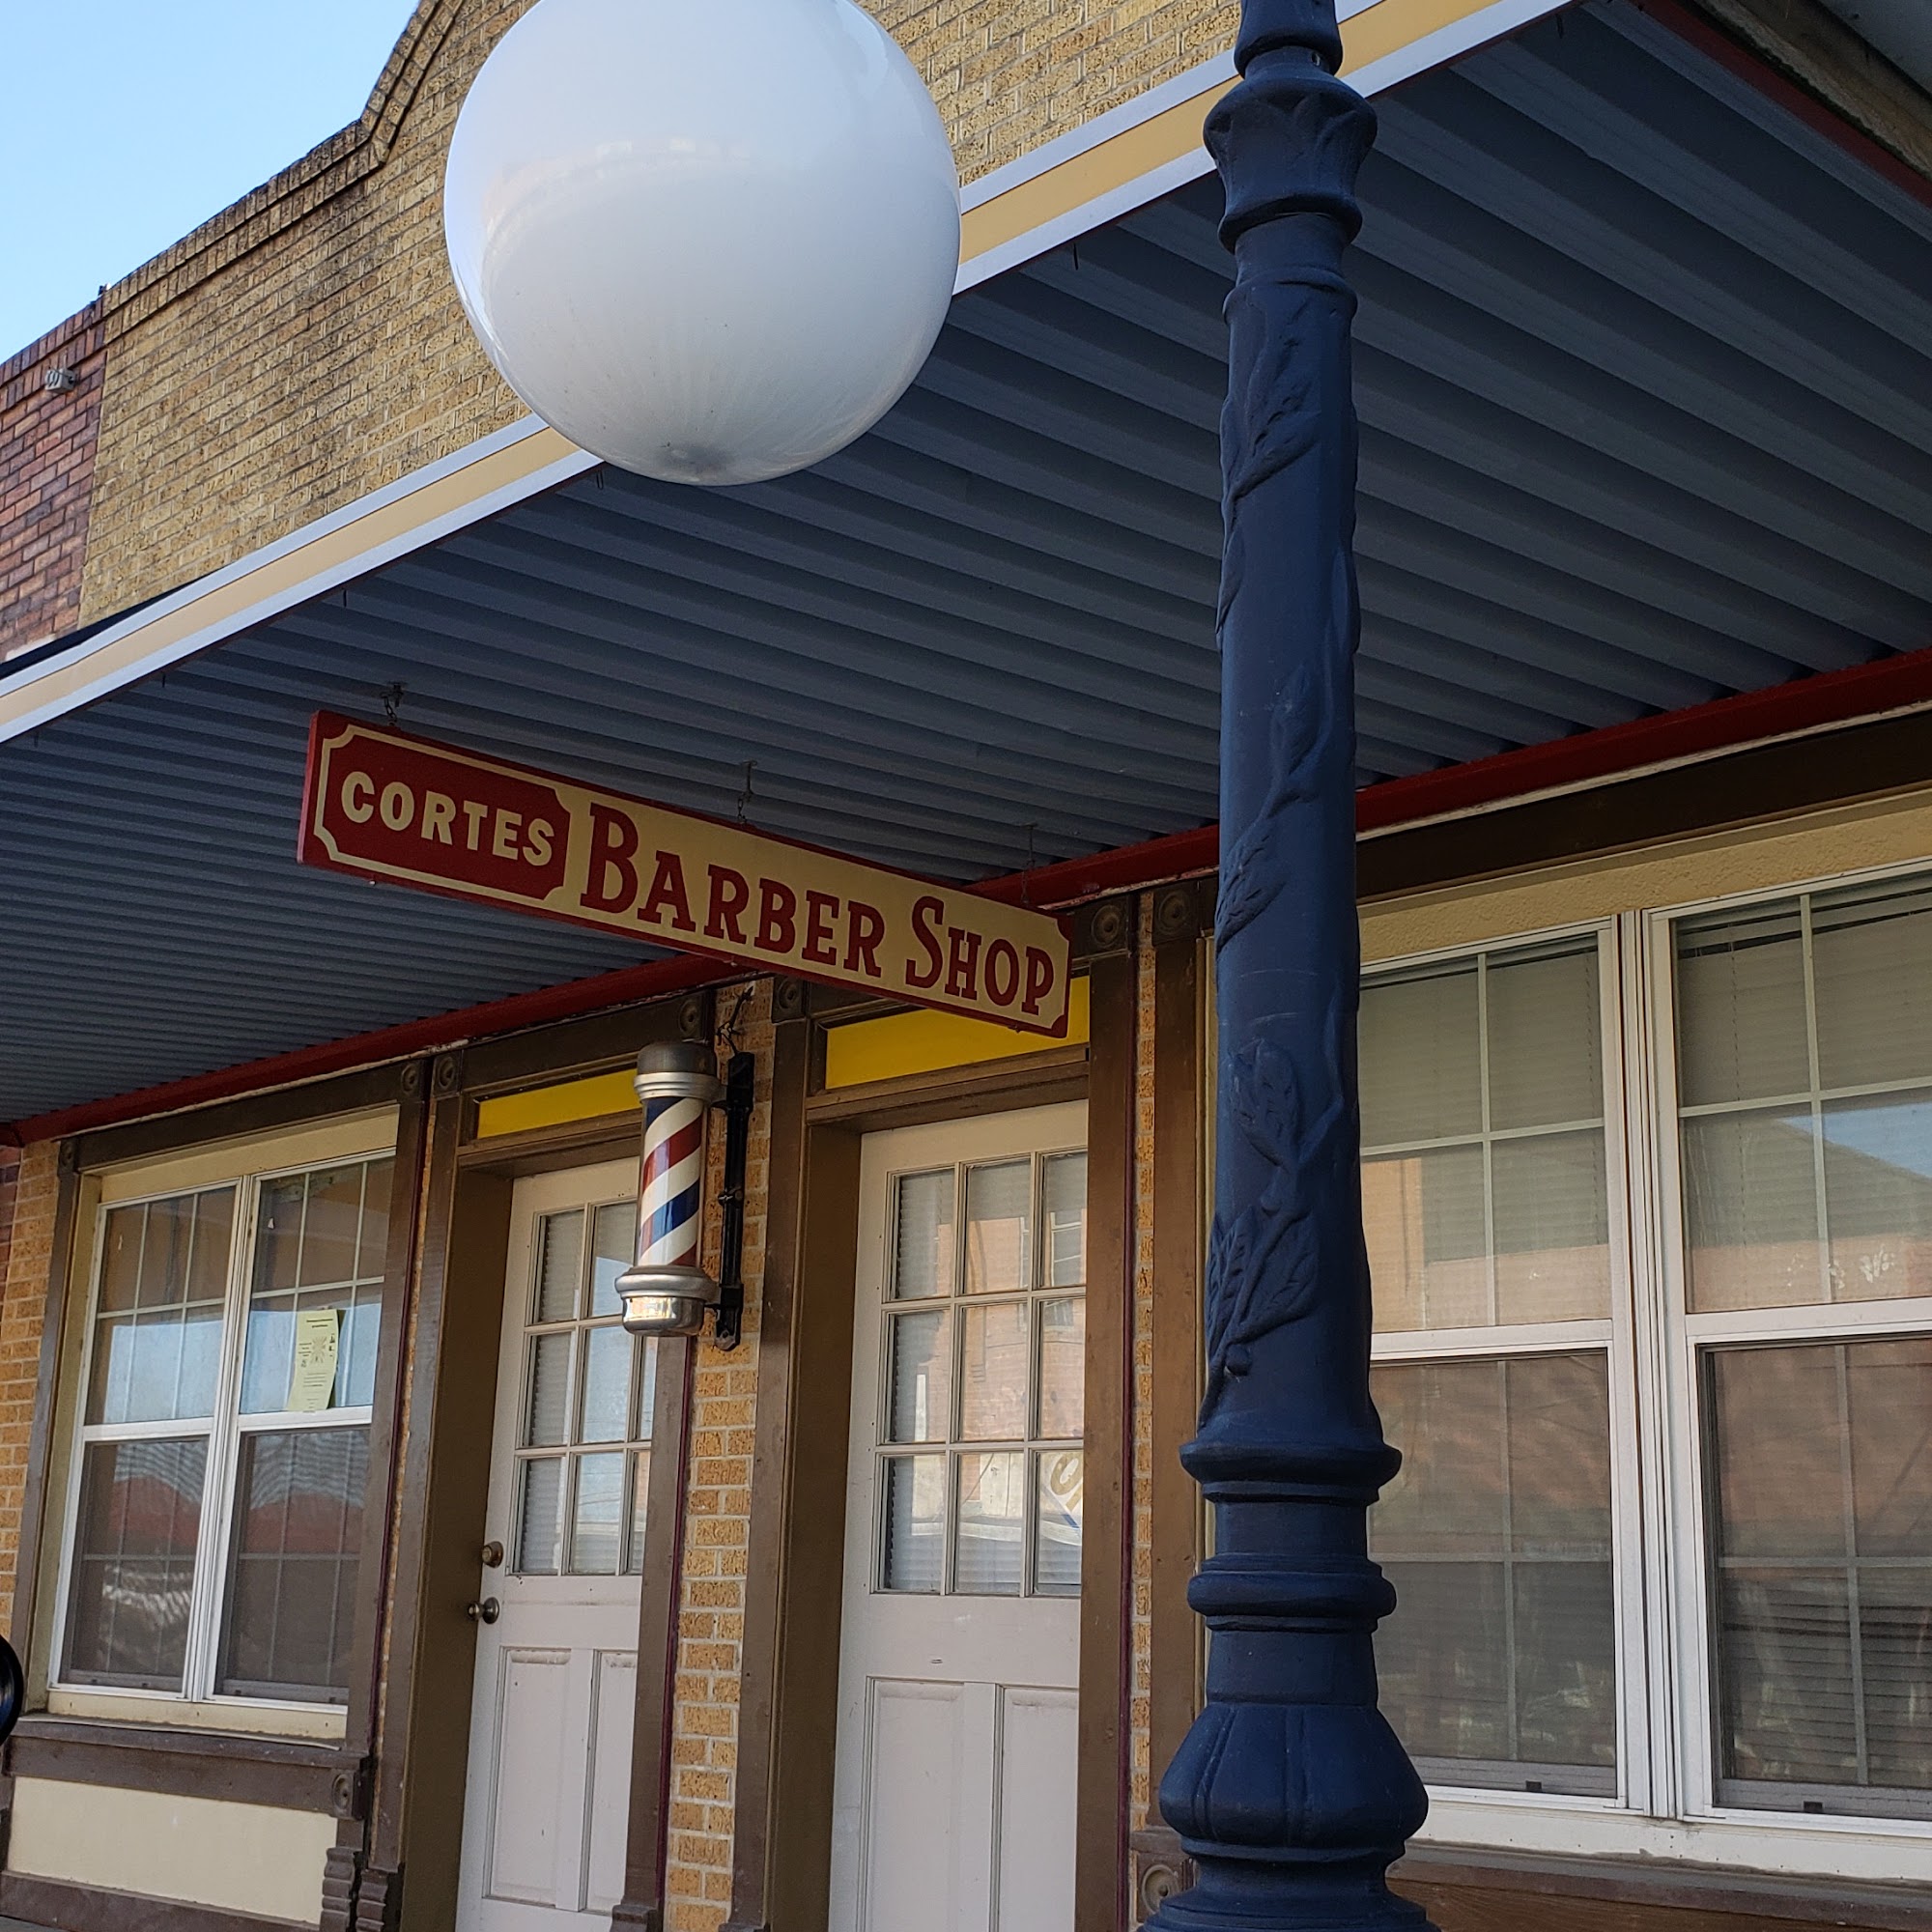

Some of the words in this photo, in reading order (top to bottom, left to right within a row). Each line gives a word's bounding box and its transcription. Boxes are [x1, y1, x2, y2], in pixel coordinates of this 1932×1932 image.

[340, 770, 554, 867] CORTES
[580, 801, 885, 978] BARBER
[906, 895, 1055, 1016] SHOP
